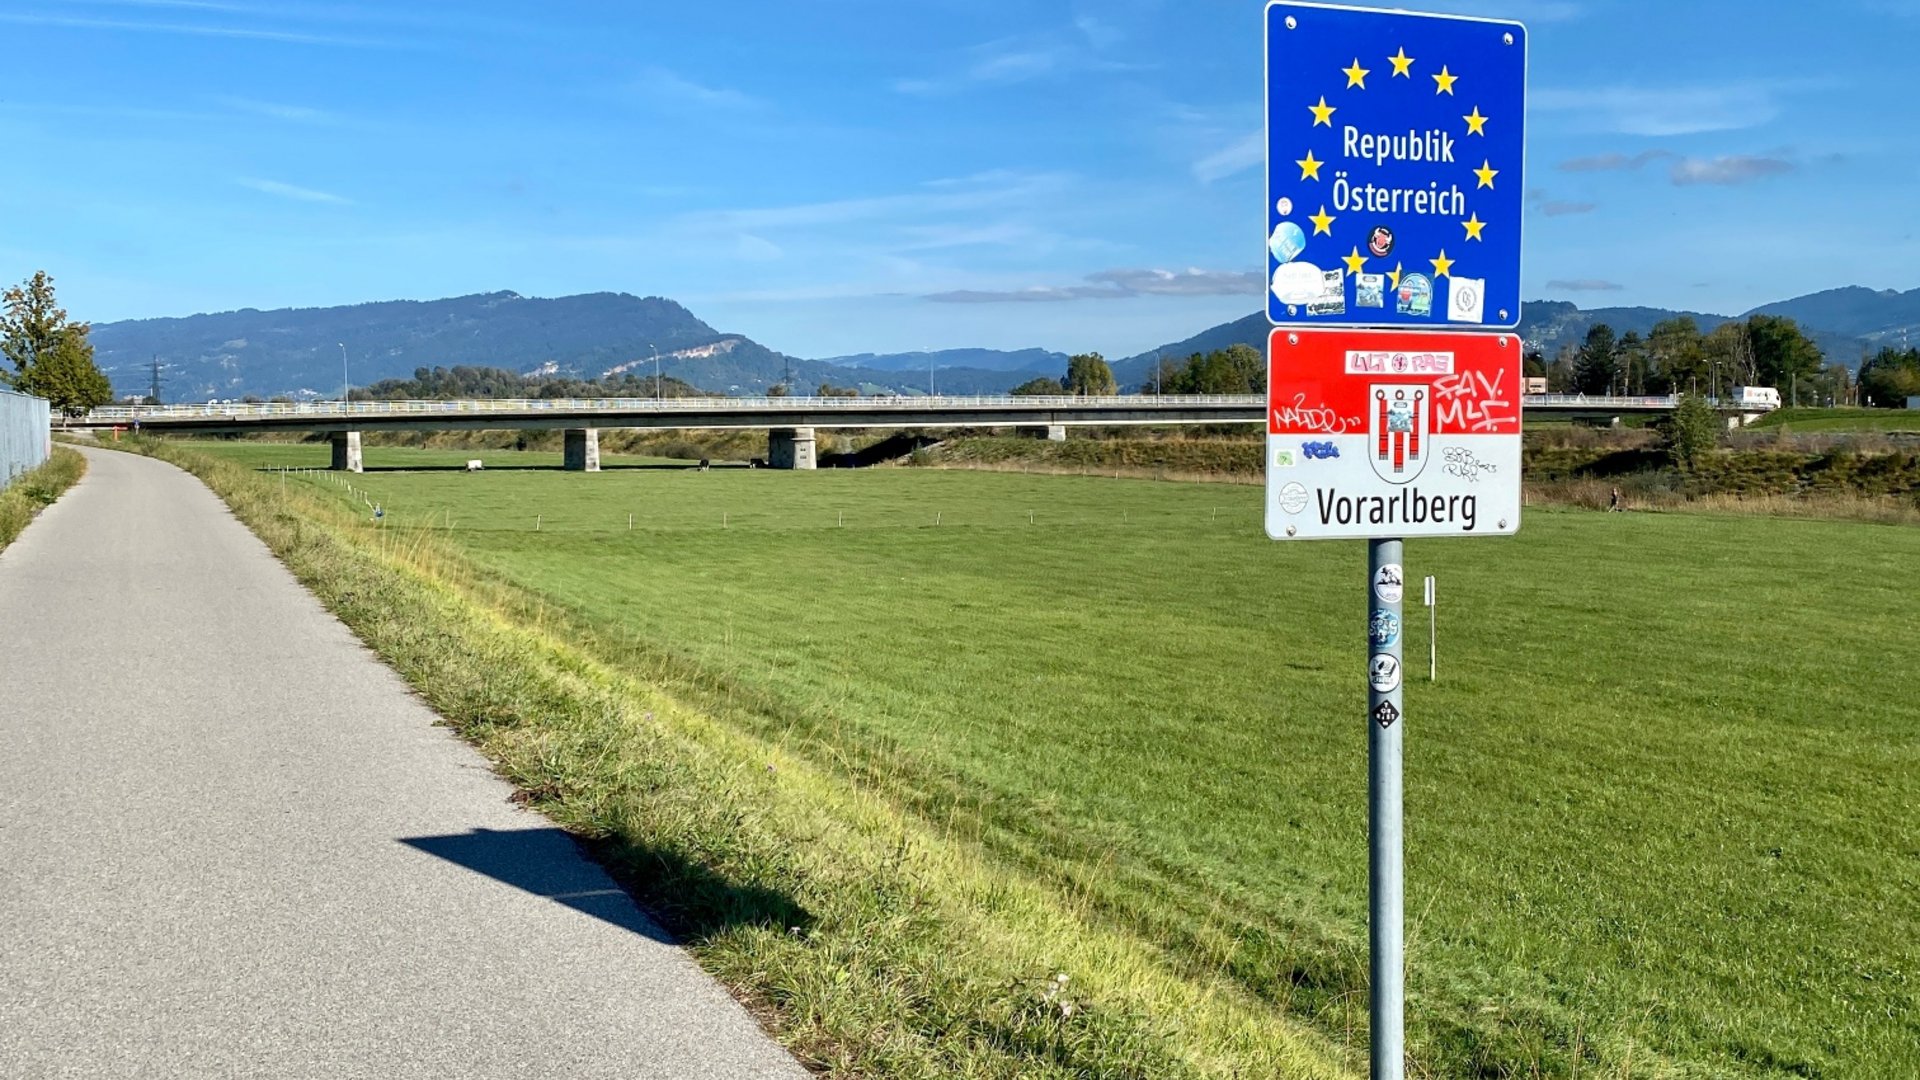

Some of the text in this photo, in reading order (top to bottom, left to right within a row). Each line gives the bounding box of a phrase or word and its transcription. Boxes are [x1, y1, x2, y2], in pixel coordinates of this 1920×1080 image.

[1343, 125, 1455, 166] Republik
[1332, 171, 1465, 215] Österreich
[1316, 488, 1477, 531] Vorarlberg
